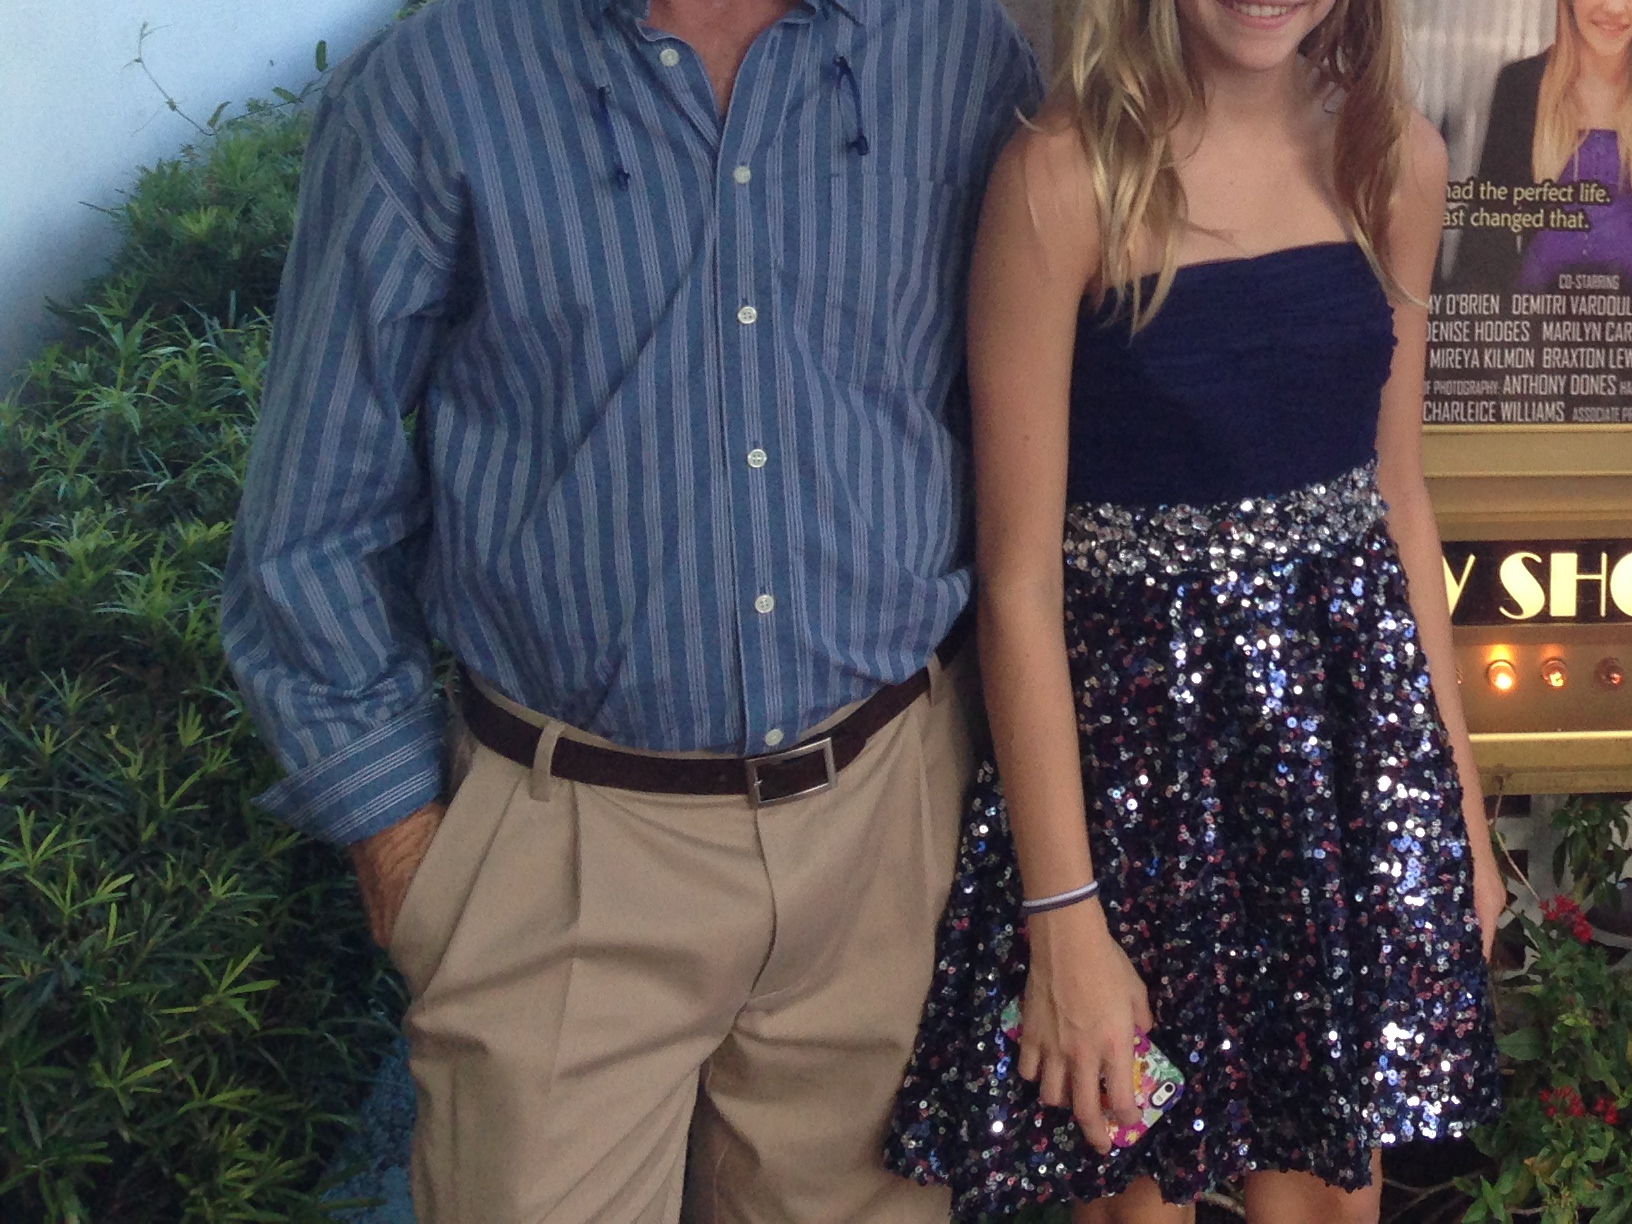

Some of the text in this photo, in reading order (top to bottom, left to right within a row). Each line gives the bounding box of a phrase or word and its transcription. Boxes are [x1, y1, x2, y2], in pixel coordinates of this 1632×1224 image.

[1480, 181, 1508, 201] the
[1513, 182, 1573, 206] perfect
[1580, 182, 1611, 202] life.
[1443, 208, 1589, 233] ast changed that.
[1559, 274, 1620, 290] CO-STARRING
[1446, 294, 1500, 315] O'BRIEN
[1512, 294, 1566, 316] DEMITRI
[1475, 320, 1531, 343] HODGES
[1542, 321, 1601, 343] MARILYN
[1429, 348, 1480, 369] MIREYA
[1483, 348, 1535, 369] KILMON
[1542, 348, 1606, 369] BRAXTON
[1502, 374, 1567, 396] ANTHONY
[1570, 374, 1618, 396] DONES
[1423, 401, 1497, 423] CHARLEICE
[1500, 401, 1566, 423] WILLIAMS
[1572, 407, 1620, 423] ASSOCIATE
